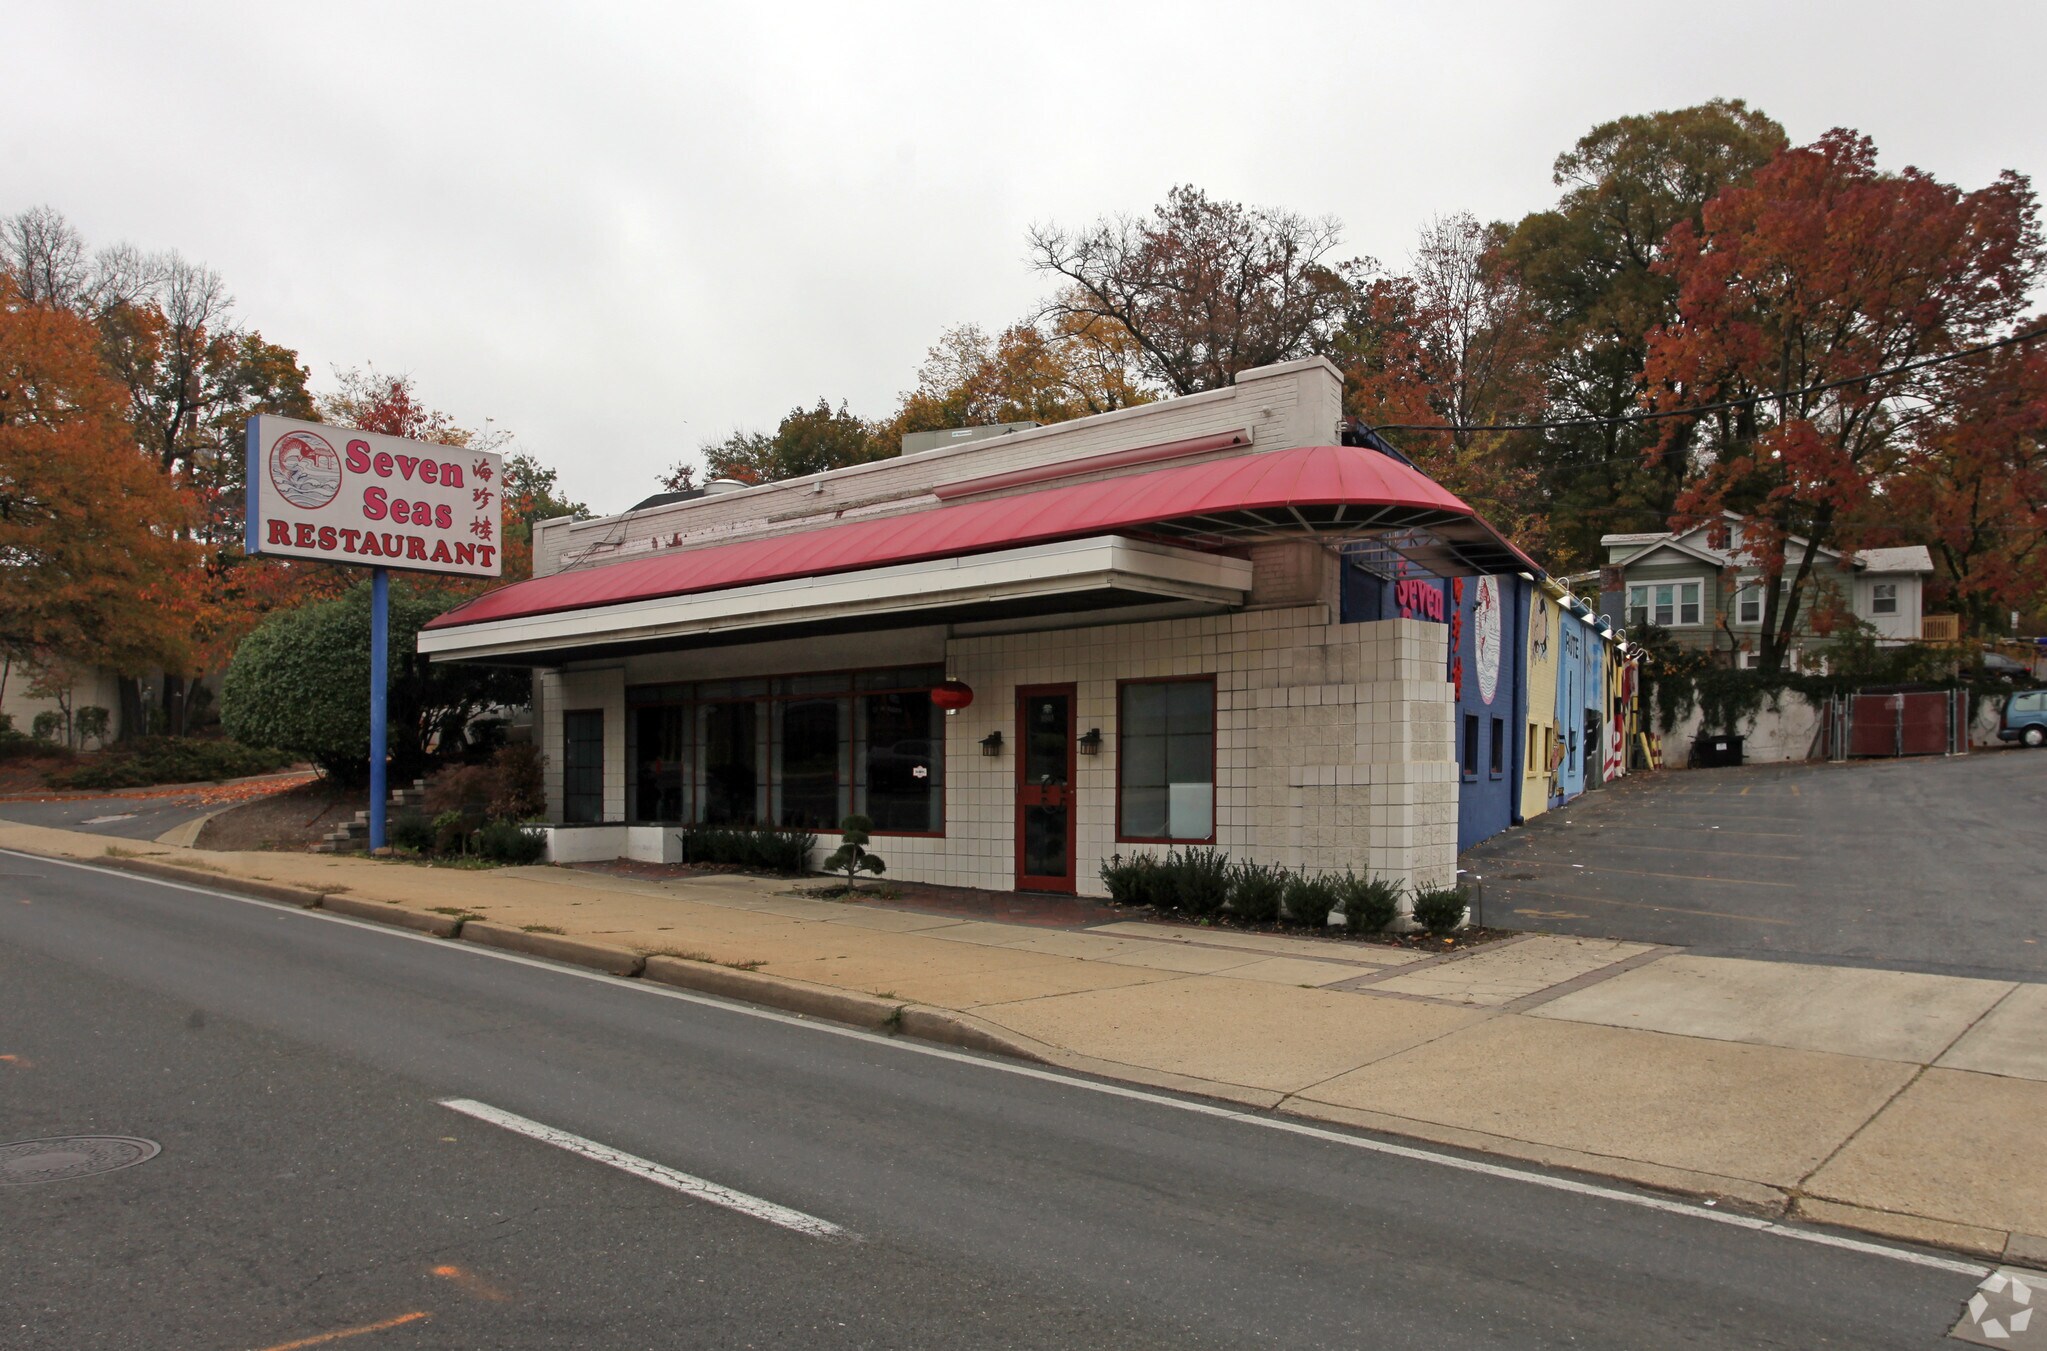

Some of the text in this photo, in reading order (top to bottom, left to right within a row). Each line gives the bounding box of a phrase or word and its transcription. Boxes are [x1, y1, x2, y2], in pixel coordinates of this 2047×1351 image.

[345, 439, 464, 488] Seven
[363, 486, 452, 529] Seas
[470, 458, 494, 541] 海珍楼
[267, 519, 496, 567] RESTAURANT
[1395, 555, 1444, 622] Seven
